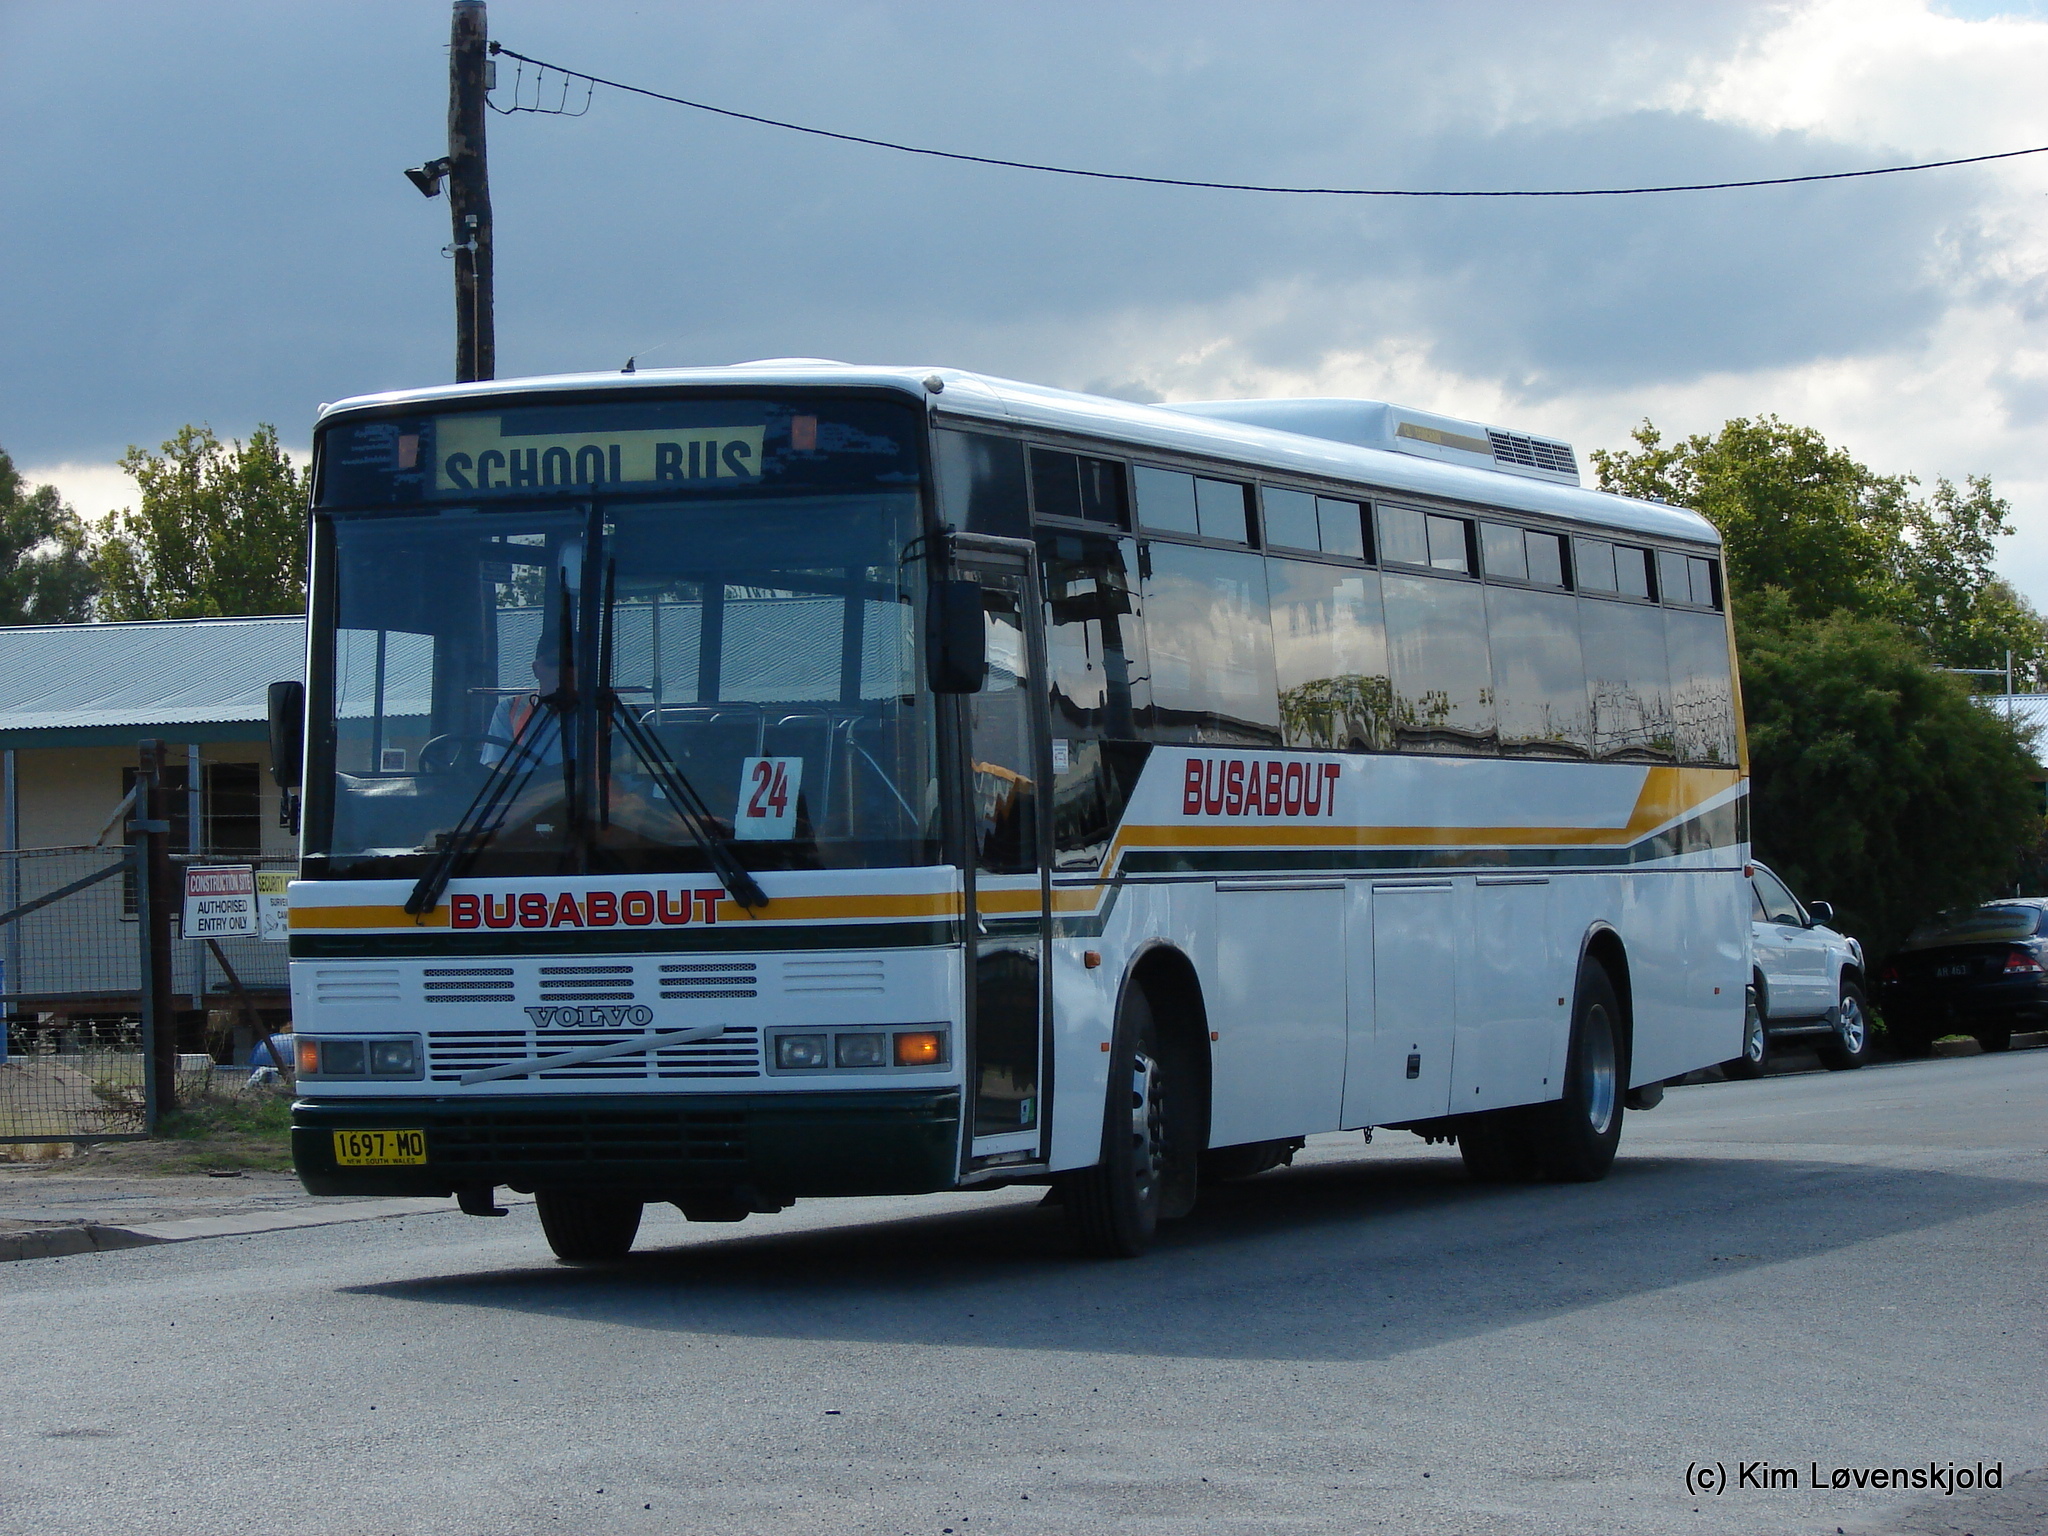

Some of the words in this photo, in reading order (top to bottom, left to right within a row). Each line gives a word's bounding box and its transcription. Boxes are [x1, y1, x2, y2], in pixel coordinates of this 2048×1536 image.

[445, 443, 622, 490] SCHOOL
[655, 440, 752, 480] BUS
[746, 760, 789, 818] 24
[1183, 758, 1341, 817] BUSABOUT
[190, 875, 239, 892] CONSTRUCTION
[240, 874, 251, 890] SITE
[258, 876, 283, 892] SECURITY
[197, 900, 247, 914] AUTHORISED
[451, 889, 726, 929] BUSABOUT
[198, 918, 227, 931] ENTRY
[229, 917, 247, 930] ONLY
[524, 1004, 653, 1028] VOLVO
